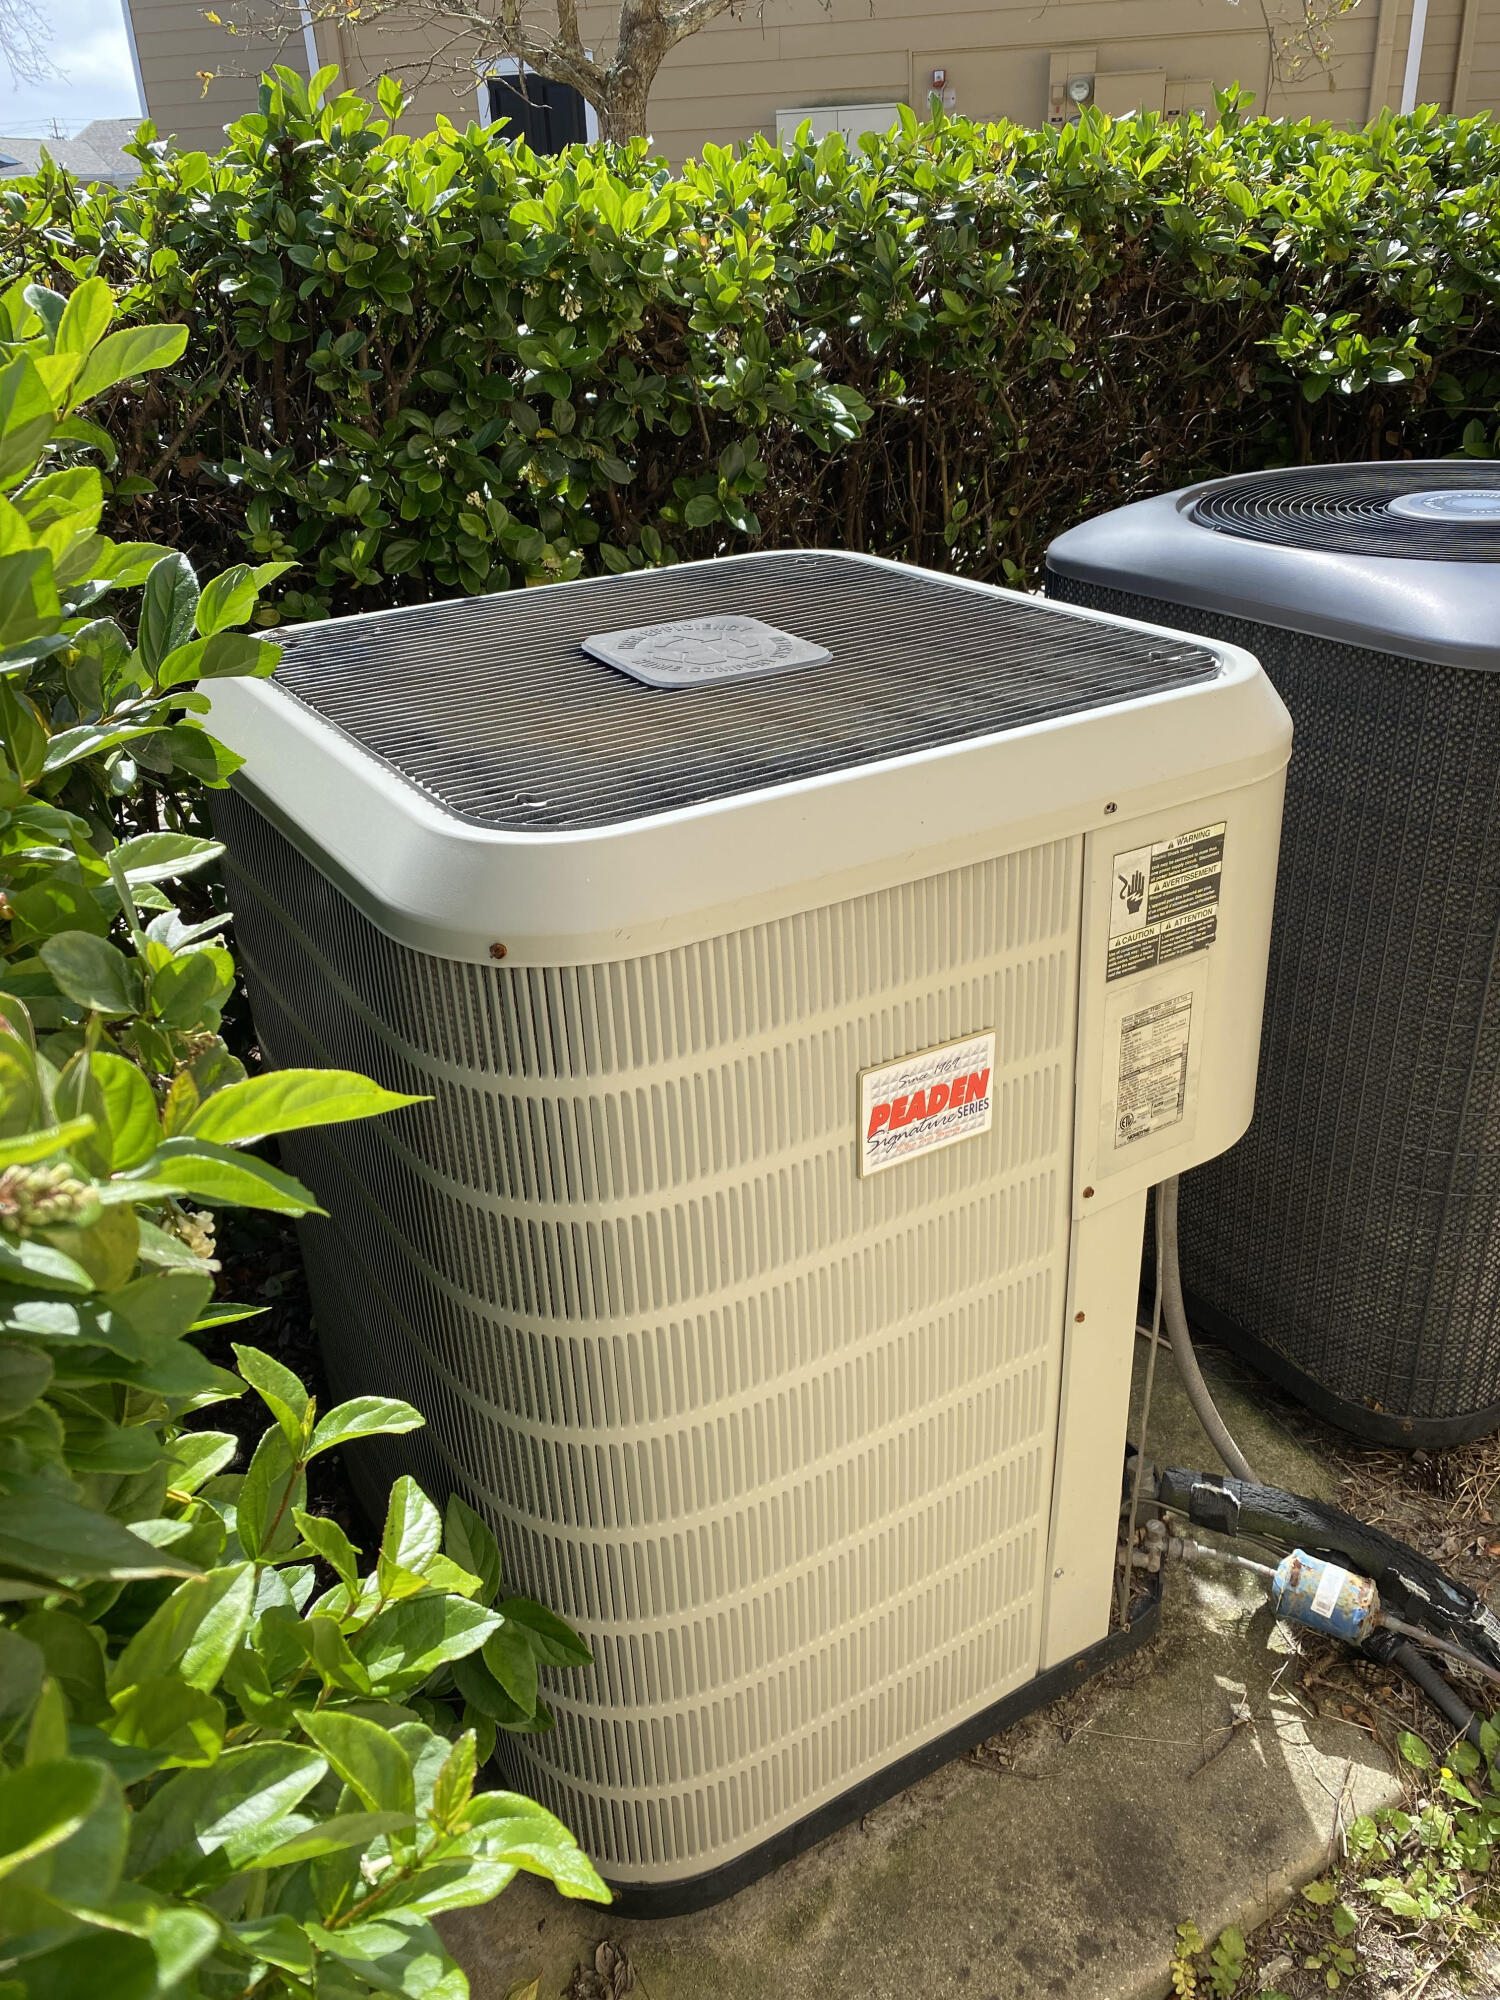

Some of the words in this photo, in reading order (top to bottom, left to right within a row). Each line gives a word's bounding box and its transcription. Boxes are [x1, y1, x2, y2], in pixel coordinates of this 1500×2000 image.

[1176, 829, 1211, 846] WARNING
[1162, 864, 1218, 889] AVERTISSEMENT
[1174, 908, 1213, 927] ATTENTION
[1122, 928, 1155, 945] CAUTION
[867, 1068, 990, 1139] PEADEN
[866, 1113, 957, 1155] Signature
[957, 1098, 989, 1119] SERIES
